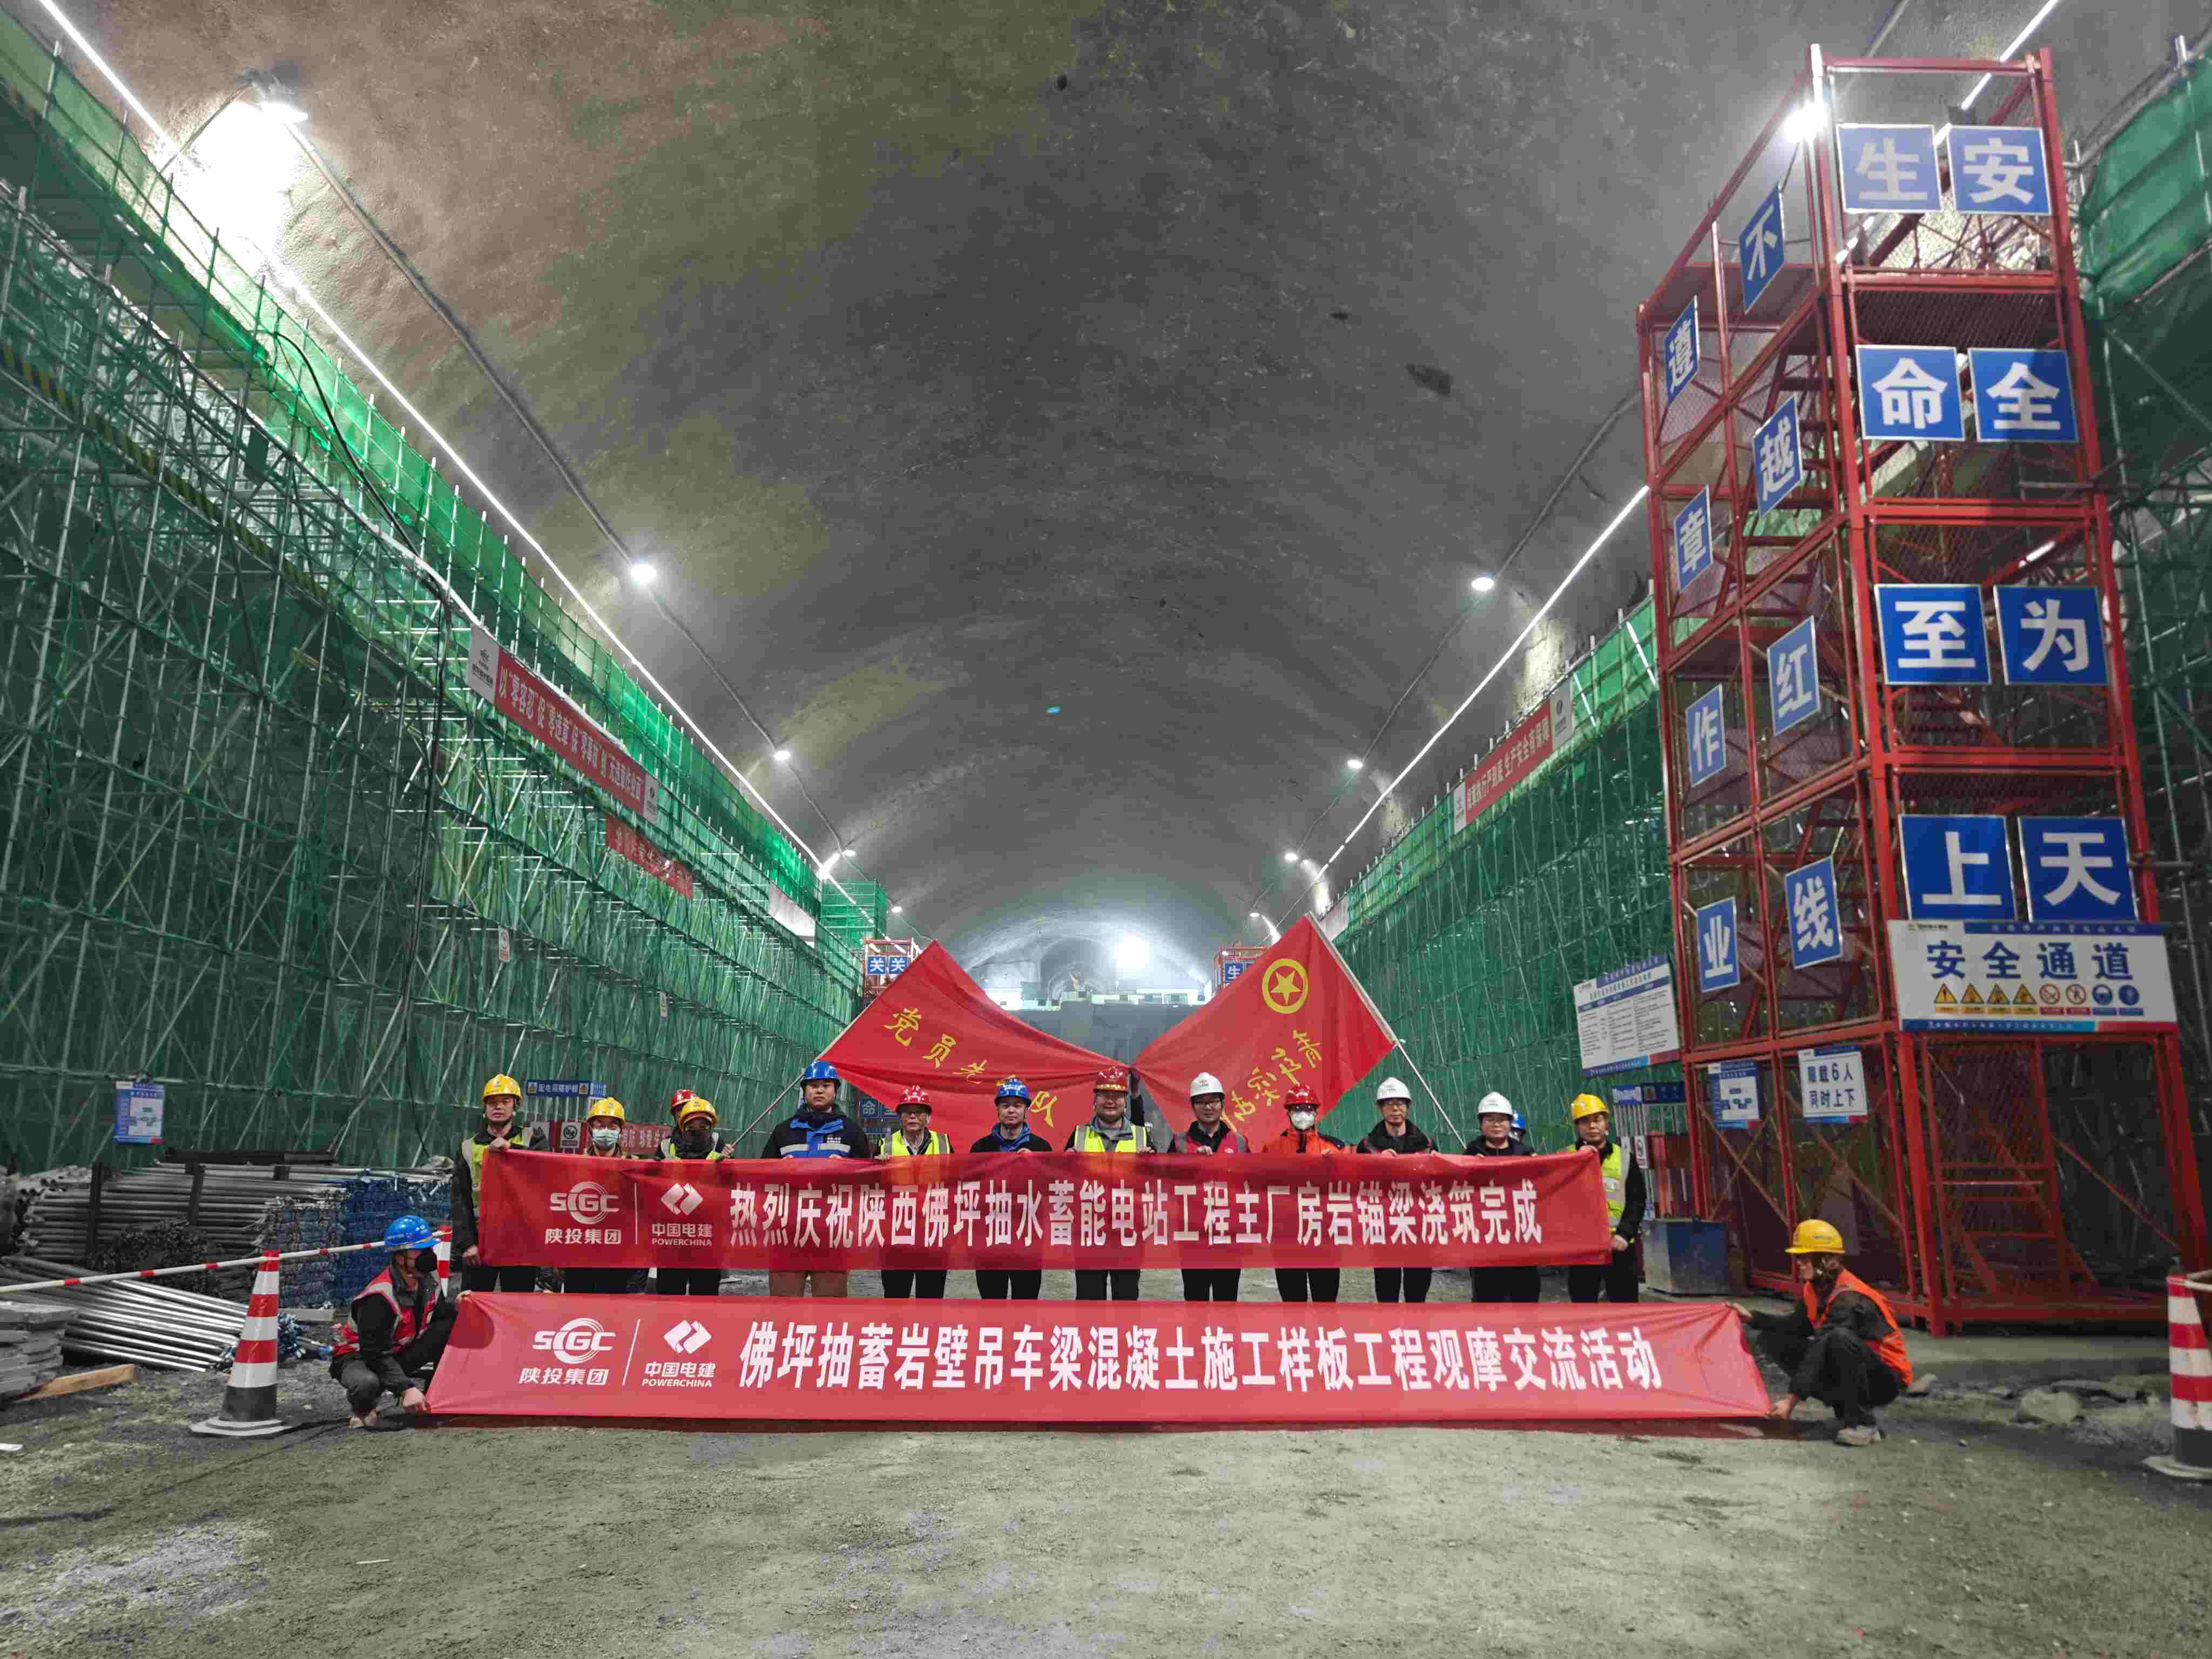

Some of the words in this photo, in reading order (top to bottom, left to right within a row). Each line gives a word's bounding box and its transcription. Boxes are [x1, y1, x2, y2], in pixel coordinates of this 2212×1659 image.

[1926, 940, 2134, 980] 安全通道
[884, 1007, 1060, 1128] 党员先队
[1808, 1062, 1853, 1082] 6人
[730, 1178, 1542, 1248] 热烈庆祝陕西佛坪抽水蓄能电站工程主厂房岩锚梁浇筑完成
[545, 1228, 621, 1244] 陕投集团
[652, 1223, 712, 1237] 中国电建
[739, 1321, 1662, 1391] 佛坪抽蓄岩壁吊车梁混凝土施工样板工程观摩交流活动
[518, 1367, 609, 1386] 陕投集团
[644, 1361, 716, 1378] 中国电建
[642, 1379, 712, 1387] POWERCHINA
